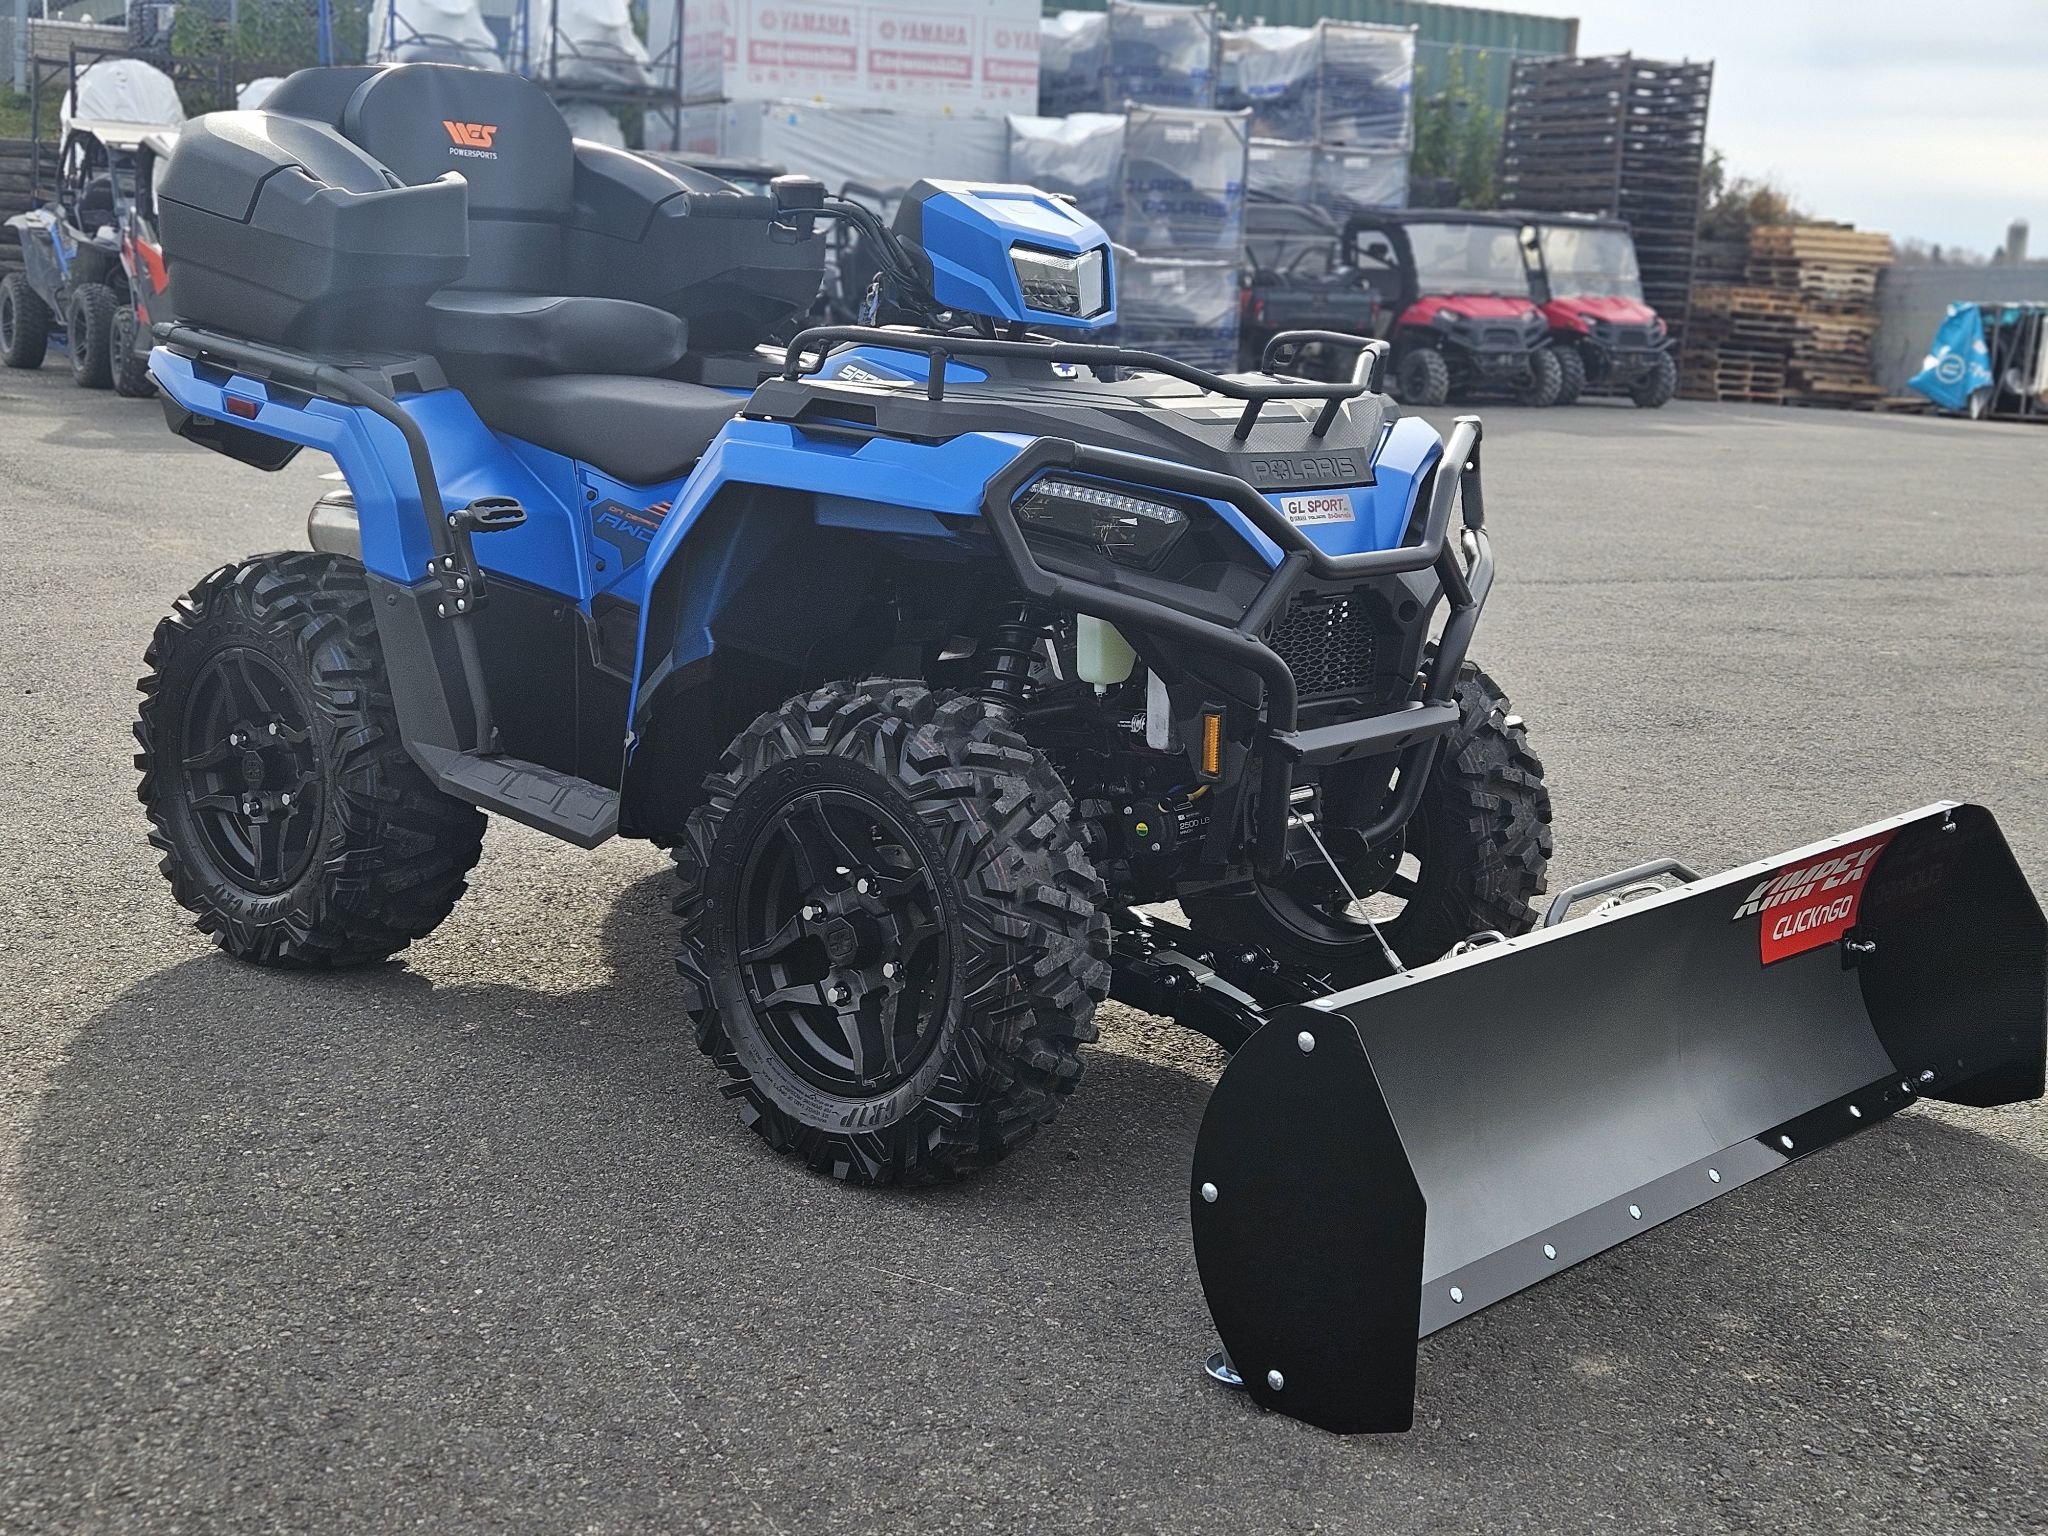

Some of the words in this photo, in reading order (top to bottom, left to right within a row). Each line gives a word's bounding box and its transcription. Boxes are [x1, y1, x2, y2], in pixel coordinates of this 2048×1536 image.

[781, 11, 850, 36] YAMAHA
[901, 21, 967, 46] YAMAHA
[443, 120, 498, 148] WES
[449, 147, 498, 160] POWERSPORTS
[1251, 457, 1357, 481] POLARIS
[1288, 501, 1305, 514] GL
[1307, 498, 1344, 512] SPORT
[1179, 819, 1200, 830] 2500
[1732, 843, 1887, 920] KIMPEX
